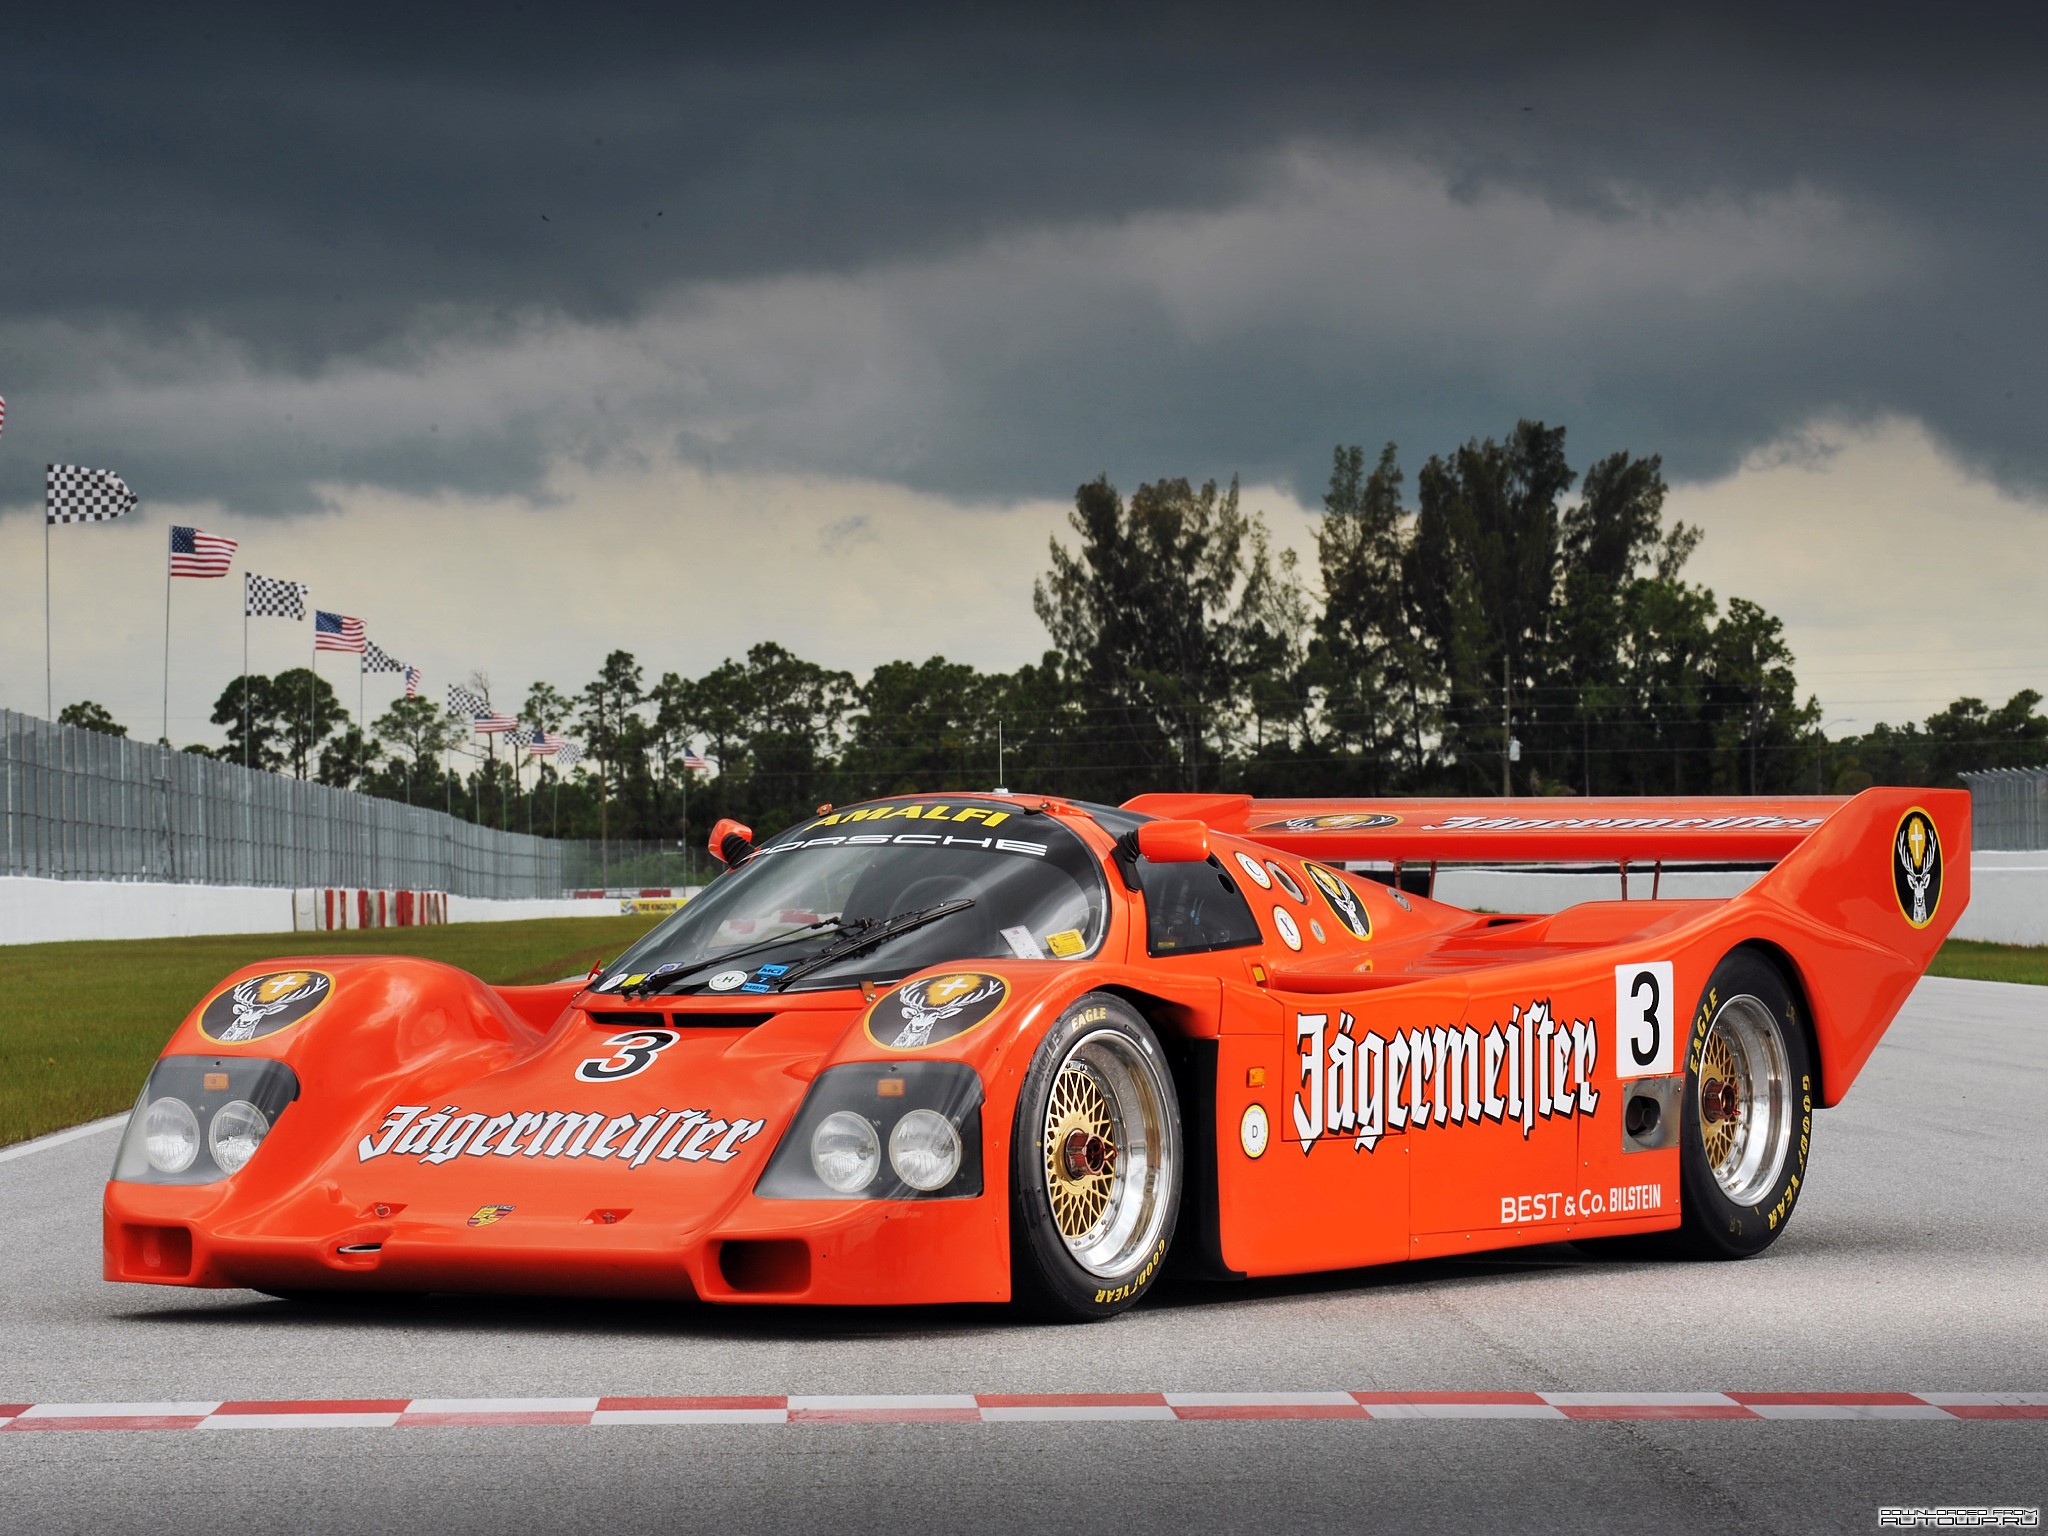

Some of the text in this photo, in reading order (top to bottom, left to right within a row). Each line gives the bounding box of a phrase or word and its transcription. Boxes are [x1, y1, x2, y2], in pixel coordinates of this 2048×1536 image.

[802, 805, 1010, 832] AMALFI
[735, 834, 1047, 866] PORSCHE
[722, 975, 738, 983] H
[1071, 1007, 1106, 1033] EAGLE
[1630, 971, 1660, 1066] 3
[1689, 987, 1718, 1077] EAGLE
[575, 1029, 681, 1083] 3
[1292, 996, 1601, 1158] Jägermeister
[357, 1104, 766, 1170] Jägermeister
[1251, 1124, 1259, 1139] D
[1500, 1184, 1661, 1224] BEST & Co. BILSTEIN
